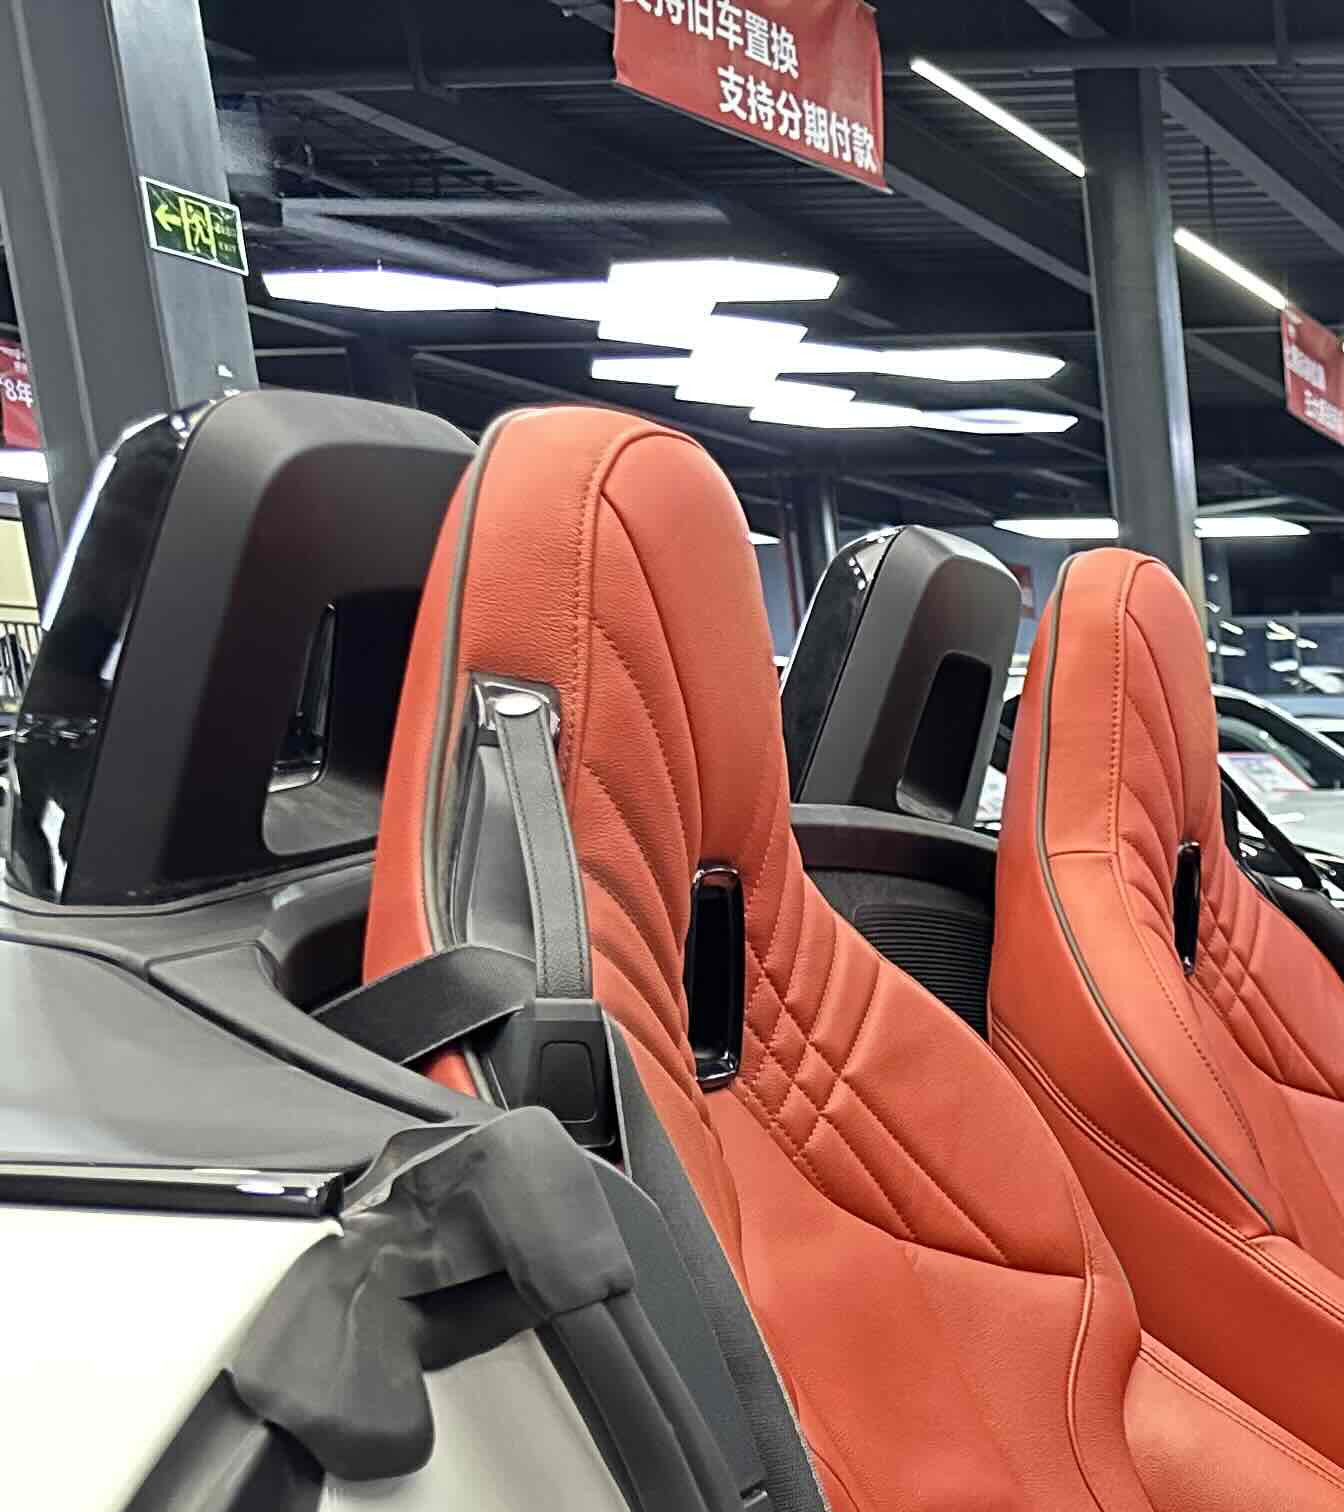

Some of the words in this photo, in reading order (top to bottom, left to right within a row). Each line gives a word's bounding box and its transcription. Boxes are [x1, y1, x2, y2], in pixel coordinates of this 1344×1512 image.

[622, 0, 799, 78] 旧车置换
[717, 65, 878, 173] 支持分期付款
[0, 376, 33, 408] 8年
